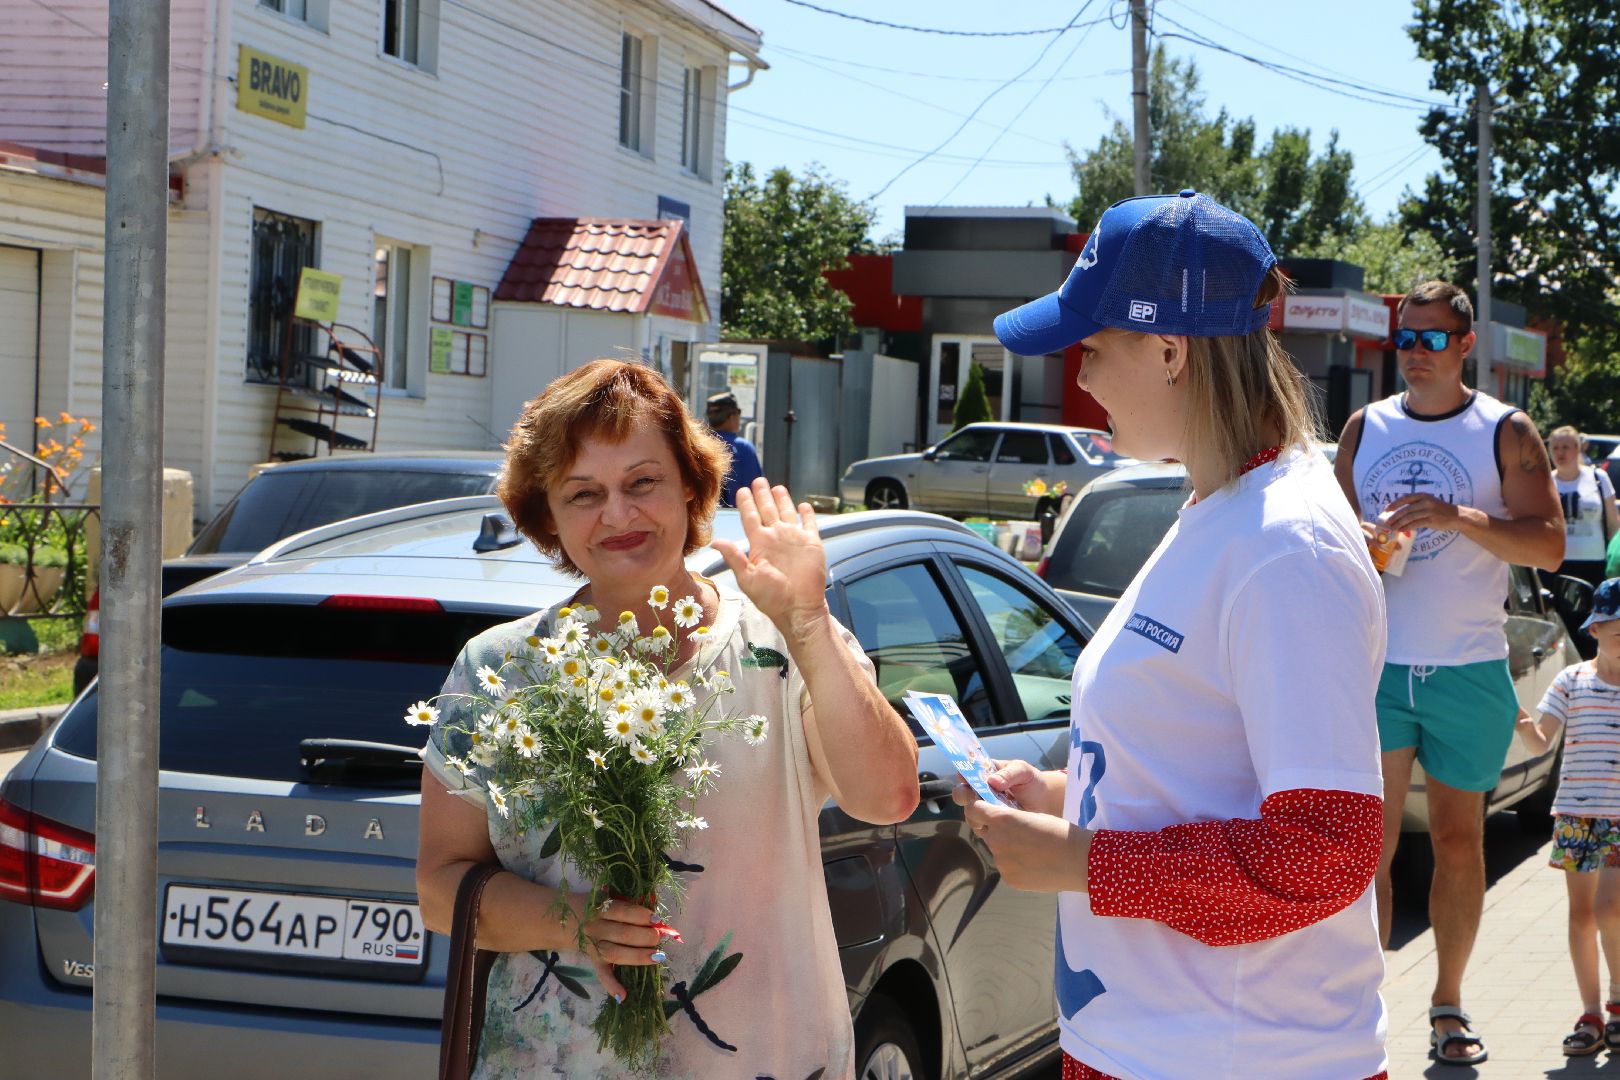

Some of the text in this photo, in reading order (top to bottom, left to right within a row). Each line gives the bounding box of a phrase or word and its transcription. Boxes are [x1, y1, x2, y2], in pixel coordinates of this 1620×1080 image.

[250, 56, 301, 103] BRAVO
[1366, 448, 1467, 492] THE WINDS OF CHANGE
[1145, 622, 1180, 649] РОССИЯ
[195, 806, 385, 840] LADA
[177, 896, 414, 949] Н564АР 790
[362, 942, 394, 956] RUS
